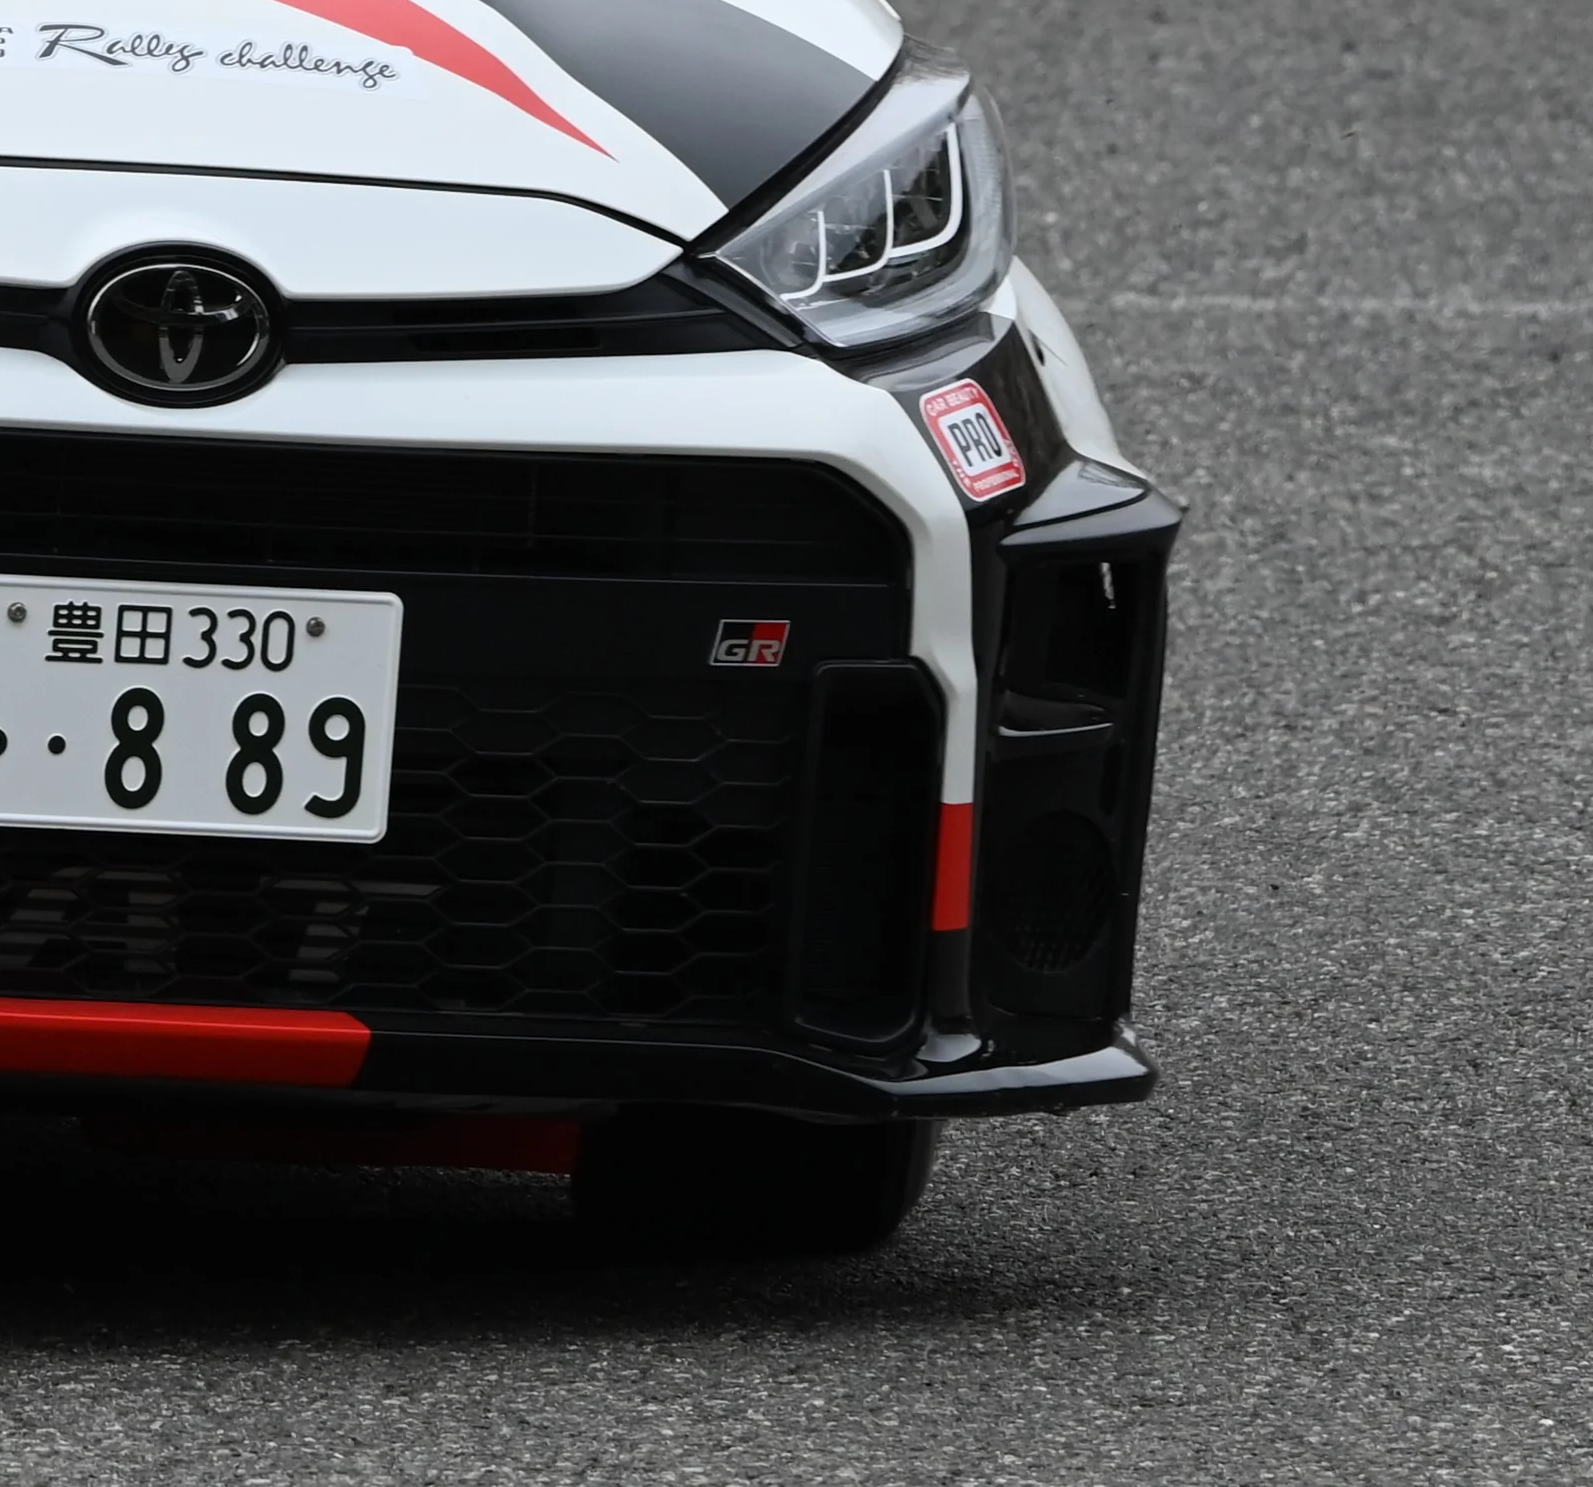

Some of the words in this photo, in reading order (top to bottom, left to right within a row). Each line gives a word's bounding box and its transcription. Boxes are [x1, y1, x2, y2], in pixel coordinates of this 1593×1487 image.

[37, 22, 205, 73] Rally
[217, 44, 399, 89] challenge
[946, 411, 1003, 468] PRO
[715, 638, 781, 663] GR
